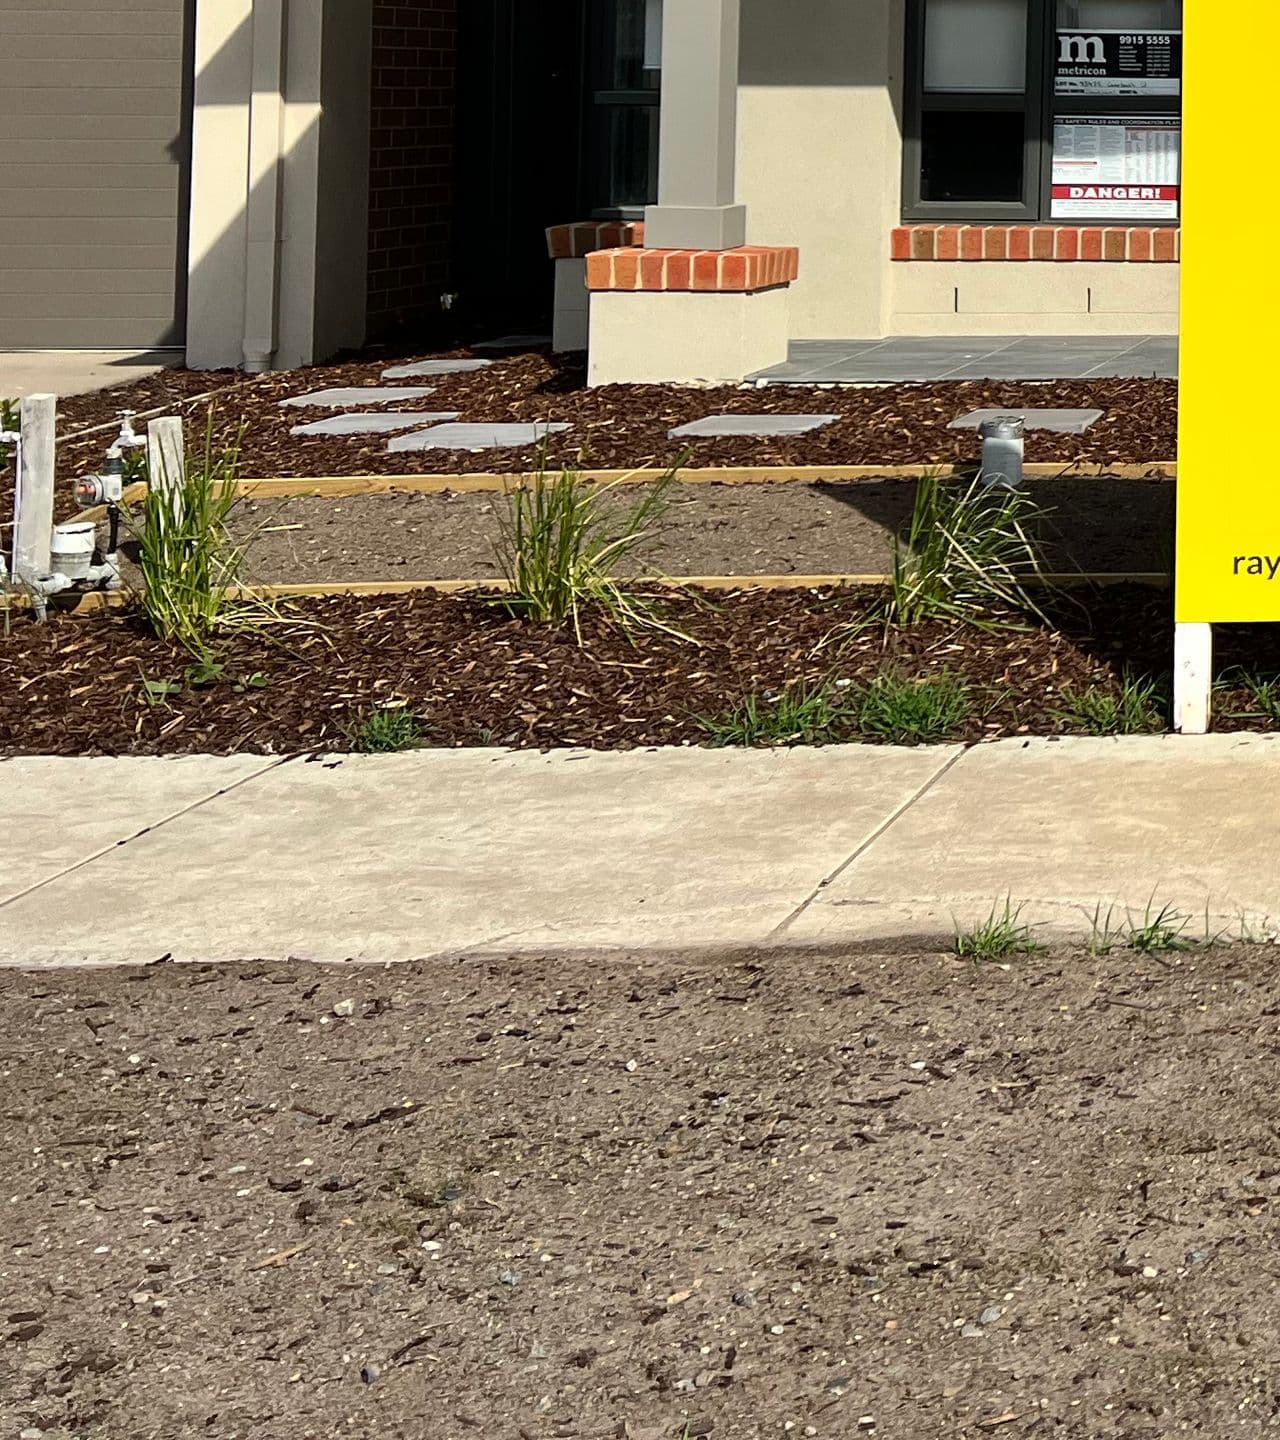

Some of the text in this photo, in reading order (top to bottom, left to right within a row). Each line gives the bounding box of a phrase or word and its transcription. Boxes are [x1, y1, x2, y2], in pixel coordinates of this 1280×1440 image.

[1119, 35, 1171, 45] 9915 5555
[1058, 65, 1107, 76] metricon
[1069, 186, 1161, 199] DANGER!
